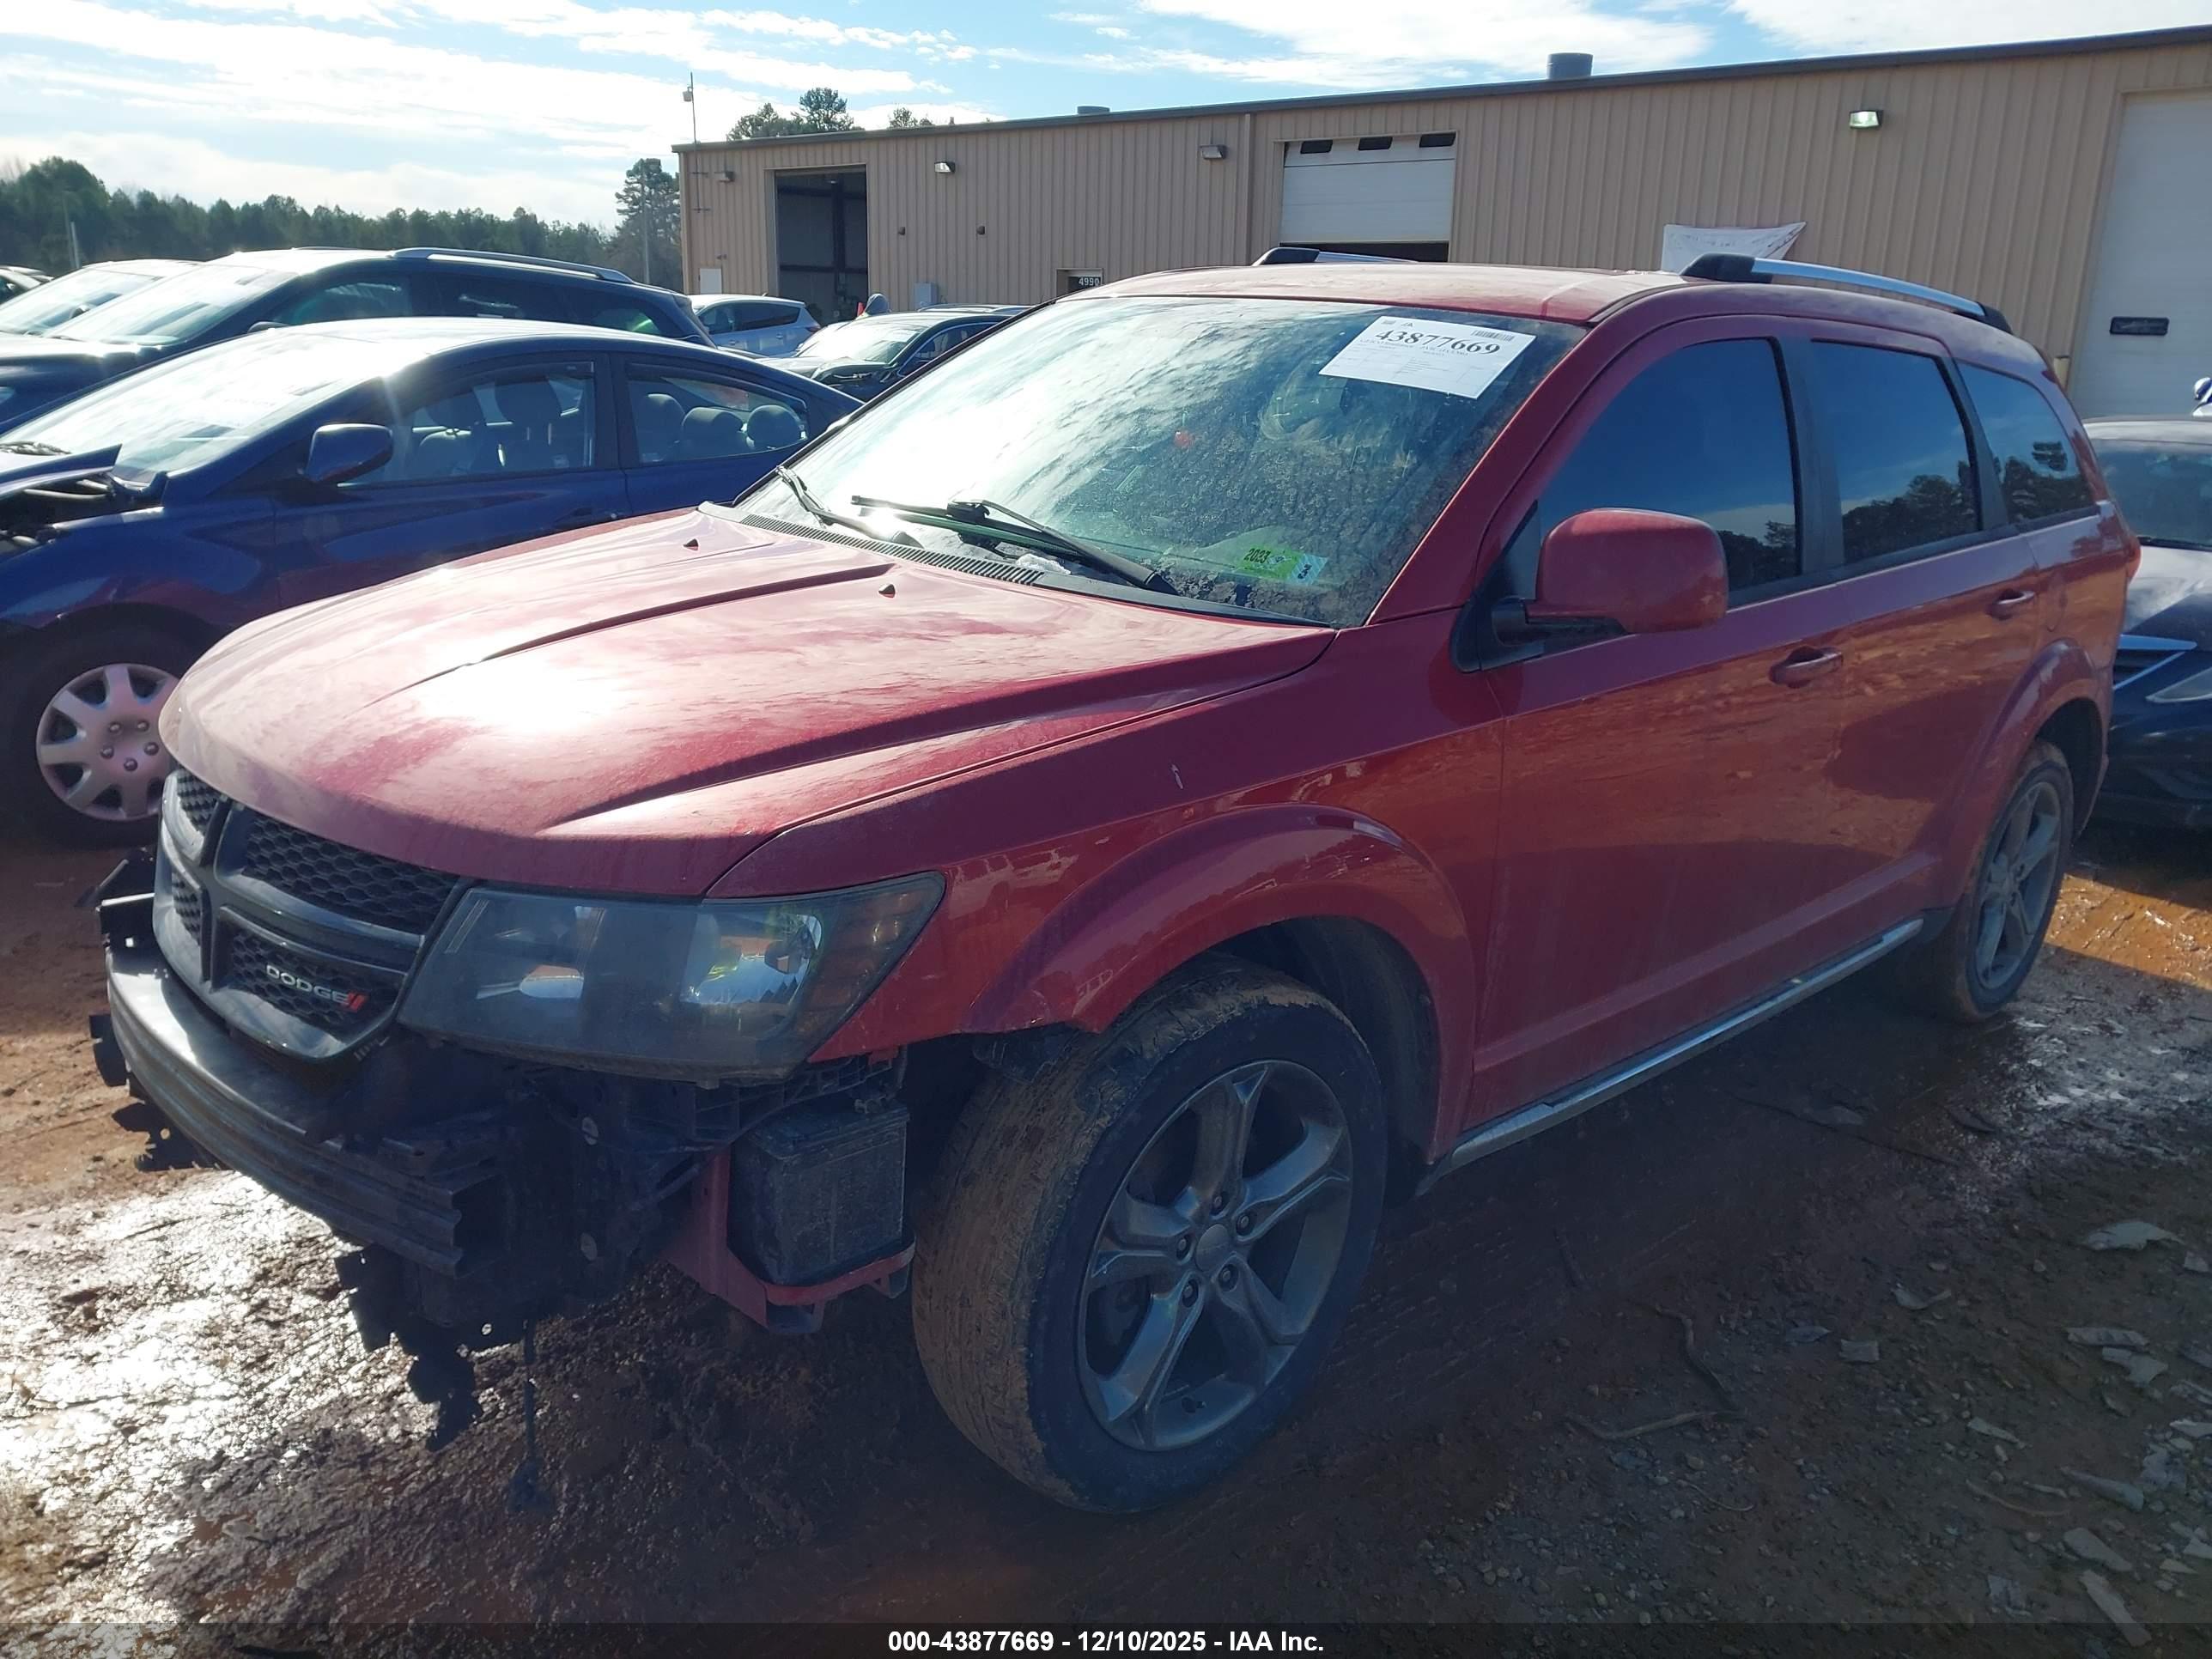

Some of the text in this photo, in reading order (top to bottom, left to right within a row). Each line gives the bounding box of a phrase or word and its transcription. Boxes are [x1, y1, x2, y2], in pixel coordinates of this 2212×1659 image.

[1079, 277, 1099, 286] 4990
[1375, 330, 1500, 354] 43877669
[1244, 548, 1271, 563] 2023
[266, 964, 349, 1005] DODGE
